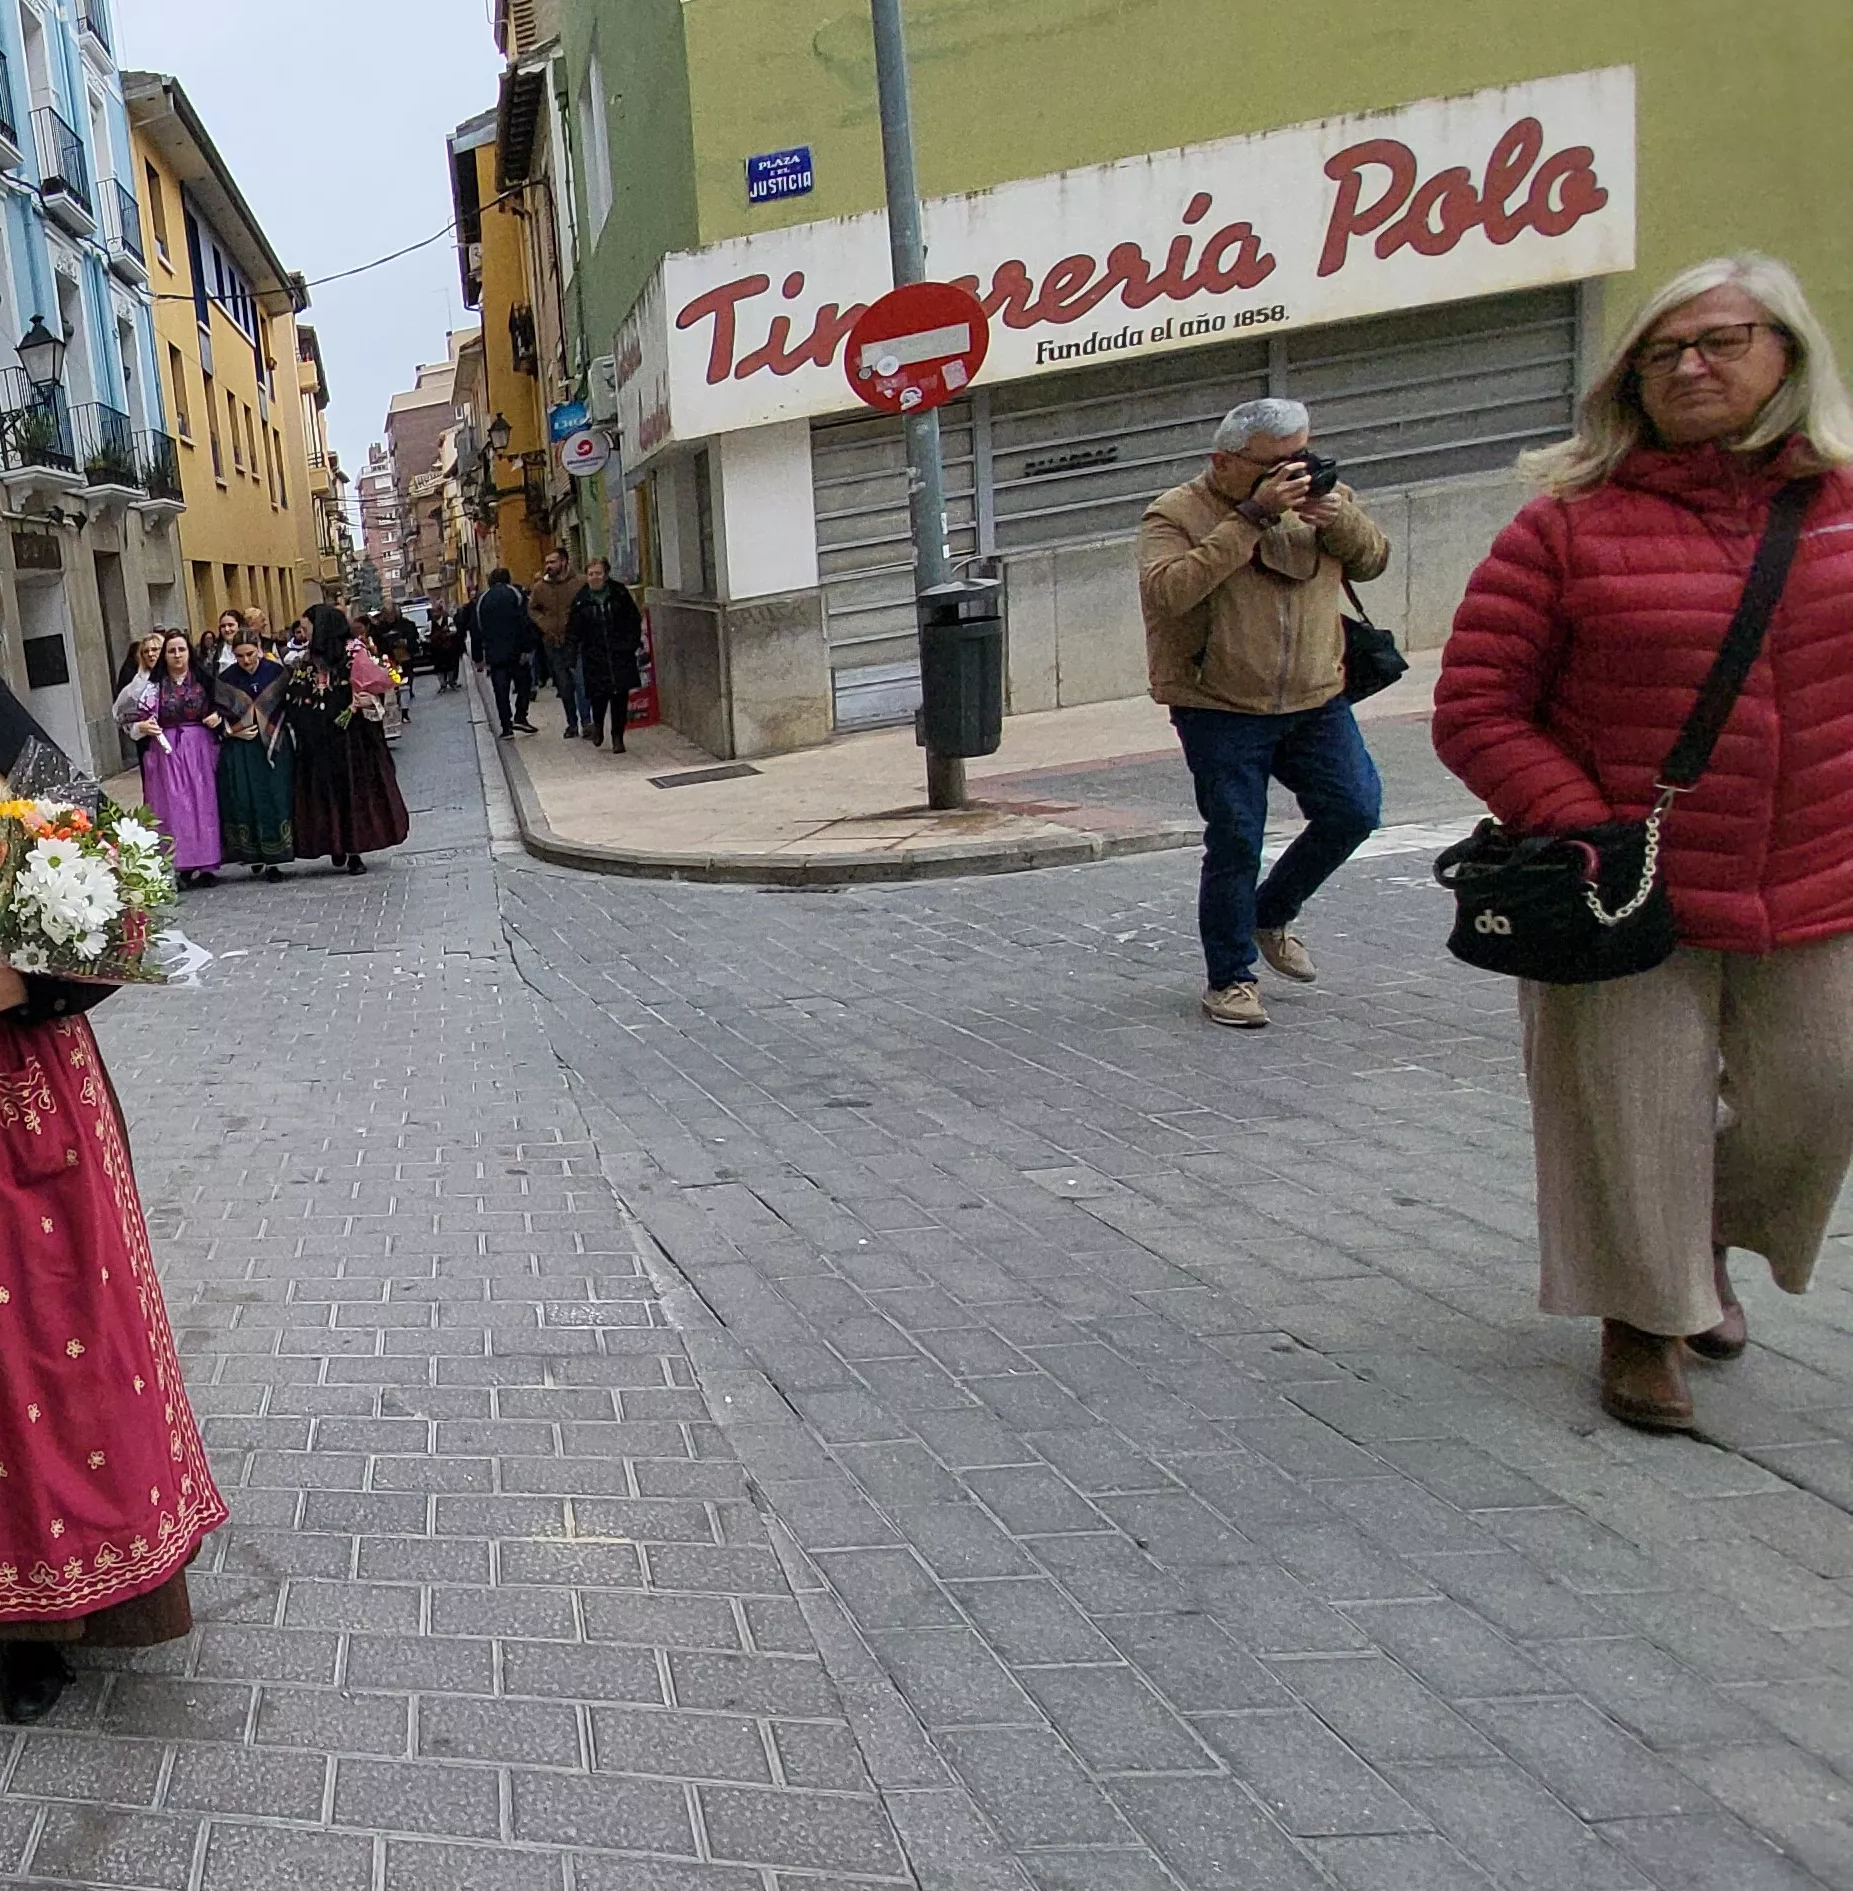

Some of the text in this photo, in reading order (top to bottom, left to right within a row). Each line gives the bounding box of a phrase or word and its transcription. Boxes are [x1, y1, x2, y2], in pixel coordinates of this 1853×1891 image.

[749, 171, 812, 198] JUSTICIA
[757, 155, 801, 171] PLAZA
[676, 116, 1609, 385] Tinrería Polo
[1036, 304, 1290, 365] Fundada el año 1858.
